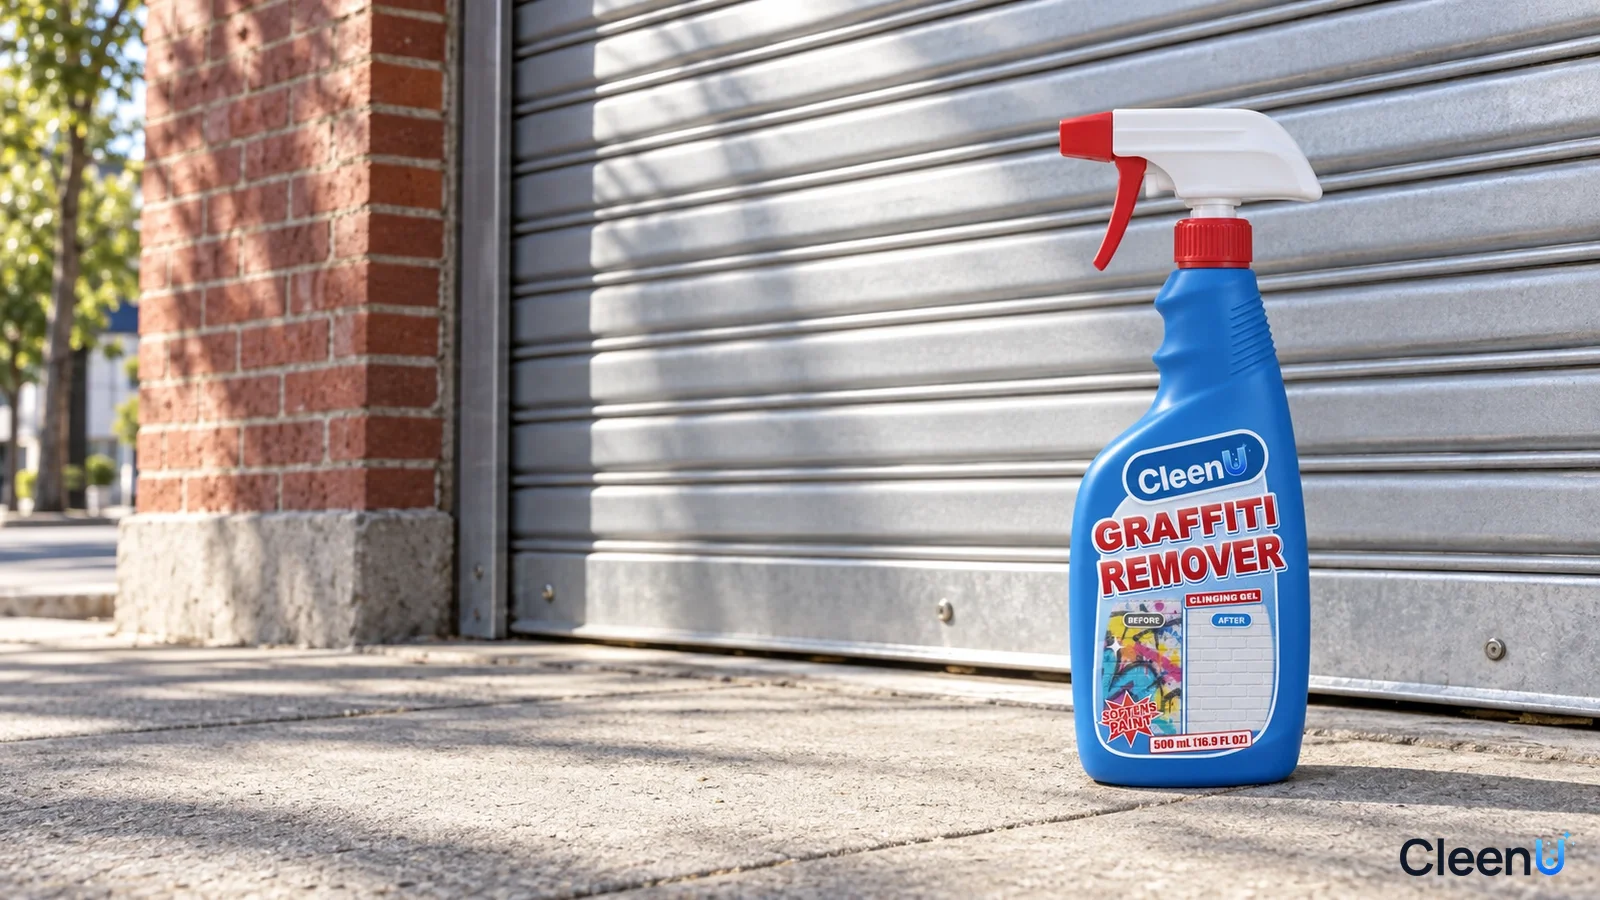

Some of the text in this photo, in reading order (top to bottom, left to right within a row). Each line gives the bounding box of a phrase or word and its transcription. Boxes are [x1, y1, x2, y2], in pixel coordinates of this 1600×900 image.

[1138, 447, 1248, 494] CleenU
[1094, 495, 1277, 552] GRAFFITI
[1099, 535, 1285, 595] REMOVER
[1189, 592, 1258, 604] CLINGING GEL
[1102, 702, 1156, 721] SOFTENS
[1110, 715, 1151, 733] PAINT
[1154, 739, 1174, 749] 500
[1176, 738, 1191, 748] mL
[1220, 736, 1230, 745] FL
